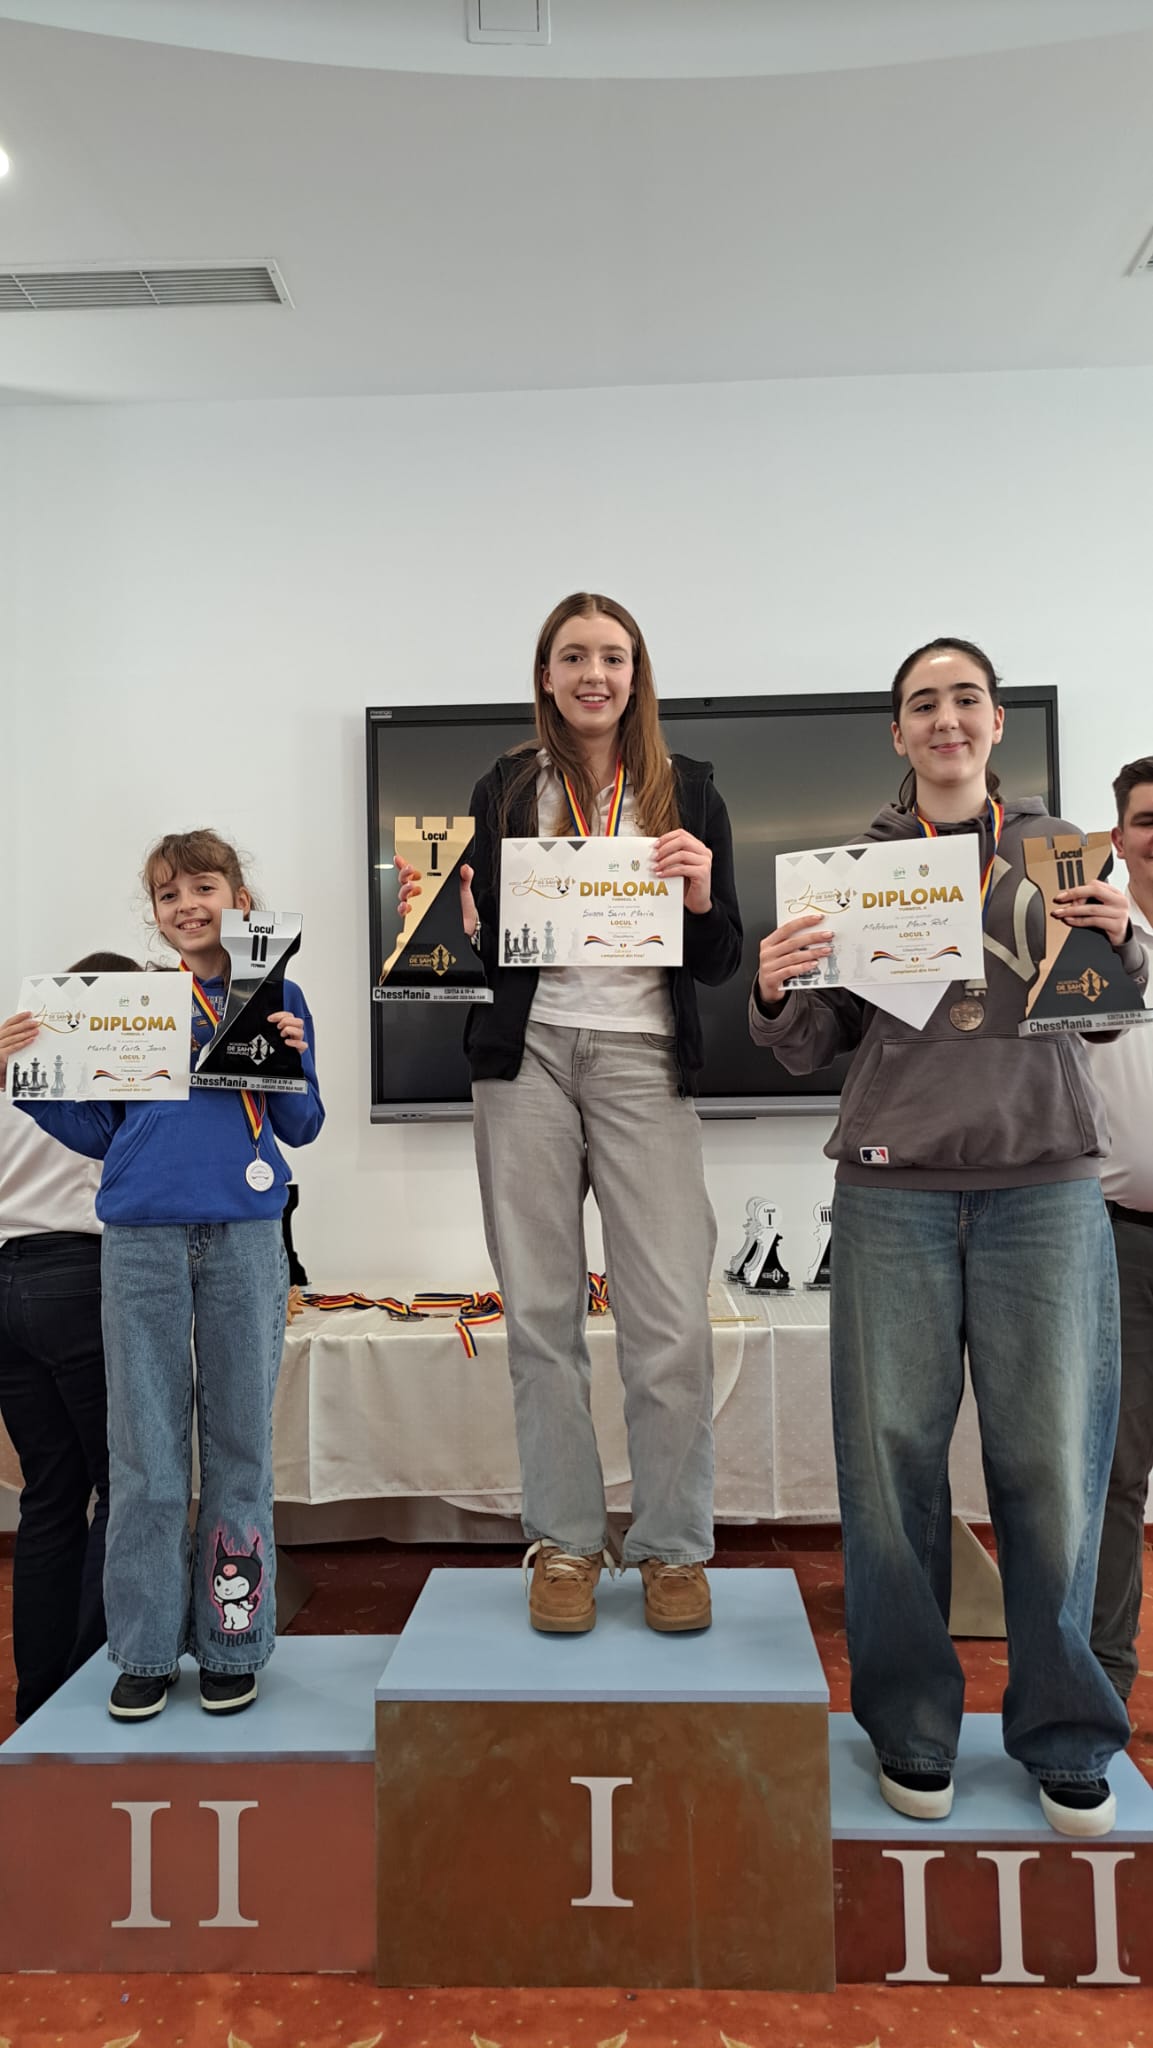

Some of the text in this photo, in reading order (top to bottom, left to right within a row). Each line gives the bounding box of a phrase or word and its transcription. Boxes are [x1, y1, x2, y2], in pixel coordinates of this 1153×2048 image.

[422, 830, 447, 841] Locul
[431, 842, 438, 869] I
[1054, 848, 1083, 860] Locul
[1056, 860, 1086, 890] III
[580, 881, 669, 897] DIPLOMA
[862, 885, 964, 909] DIPLOMA
[249, 922, 275, 935] Locul
[899, 931, 924, 939] LOCUL
[251, 934, 268, 962] II
[374, 988, 431, 1000] ChessMania
[89, 1016, 176, 1031] DIPLOMA
[1029, 1017, 1093, 1033] ChessMania
[190, 1075, 248, 1088] ChessMania
[209, 1627, 263, 1647] KUROMI
[570, 1776, 634, 1907] I
[111, 1800, 259, 1928] II
[882, 1850, 1141, 1984] III
